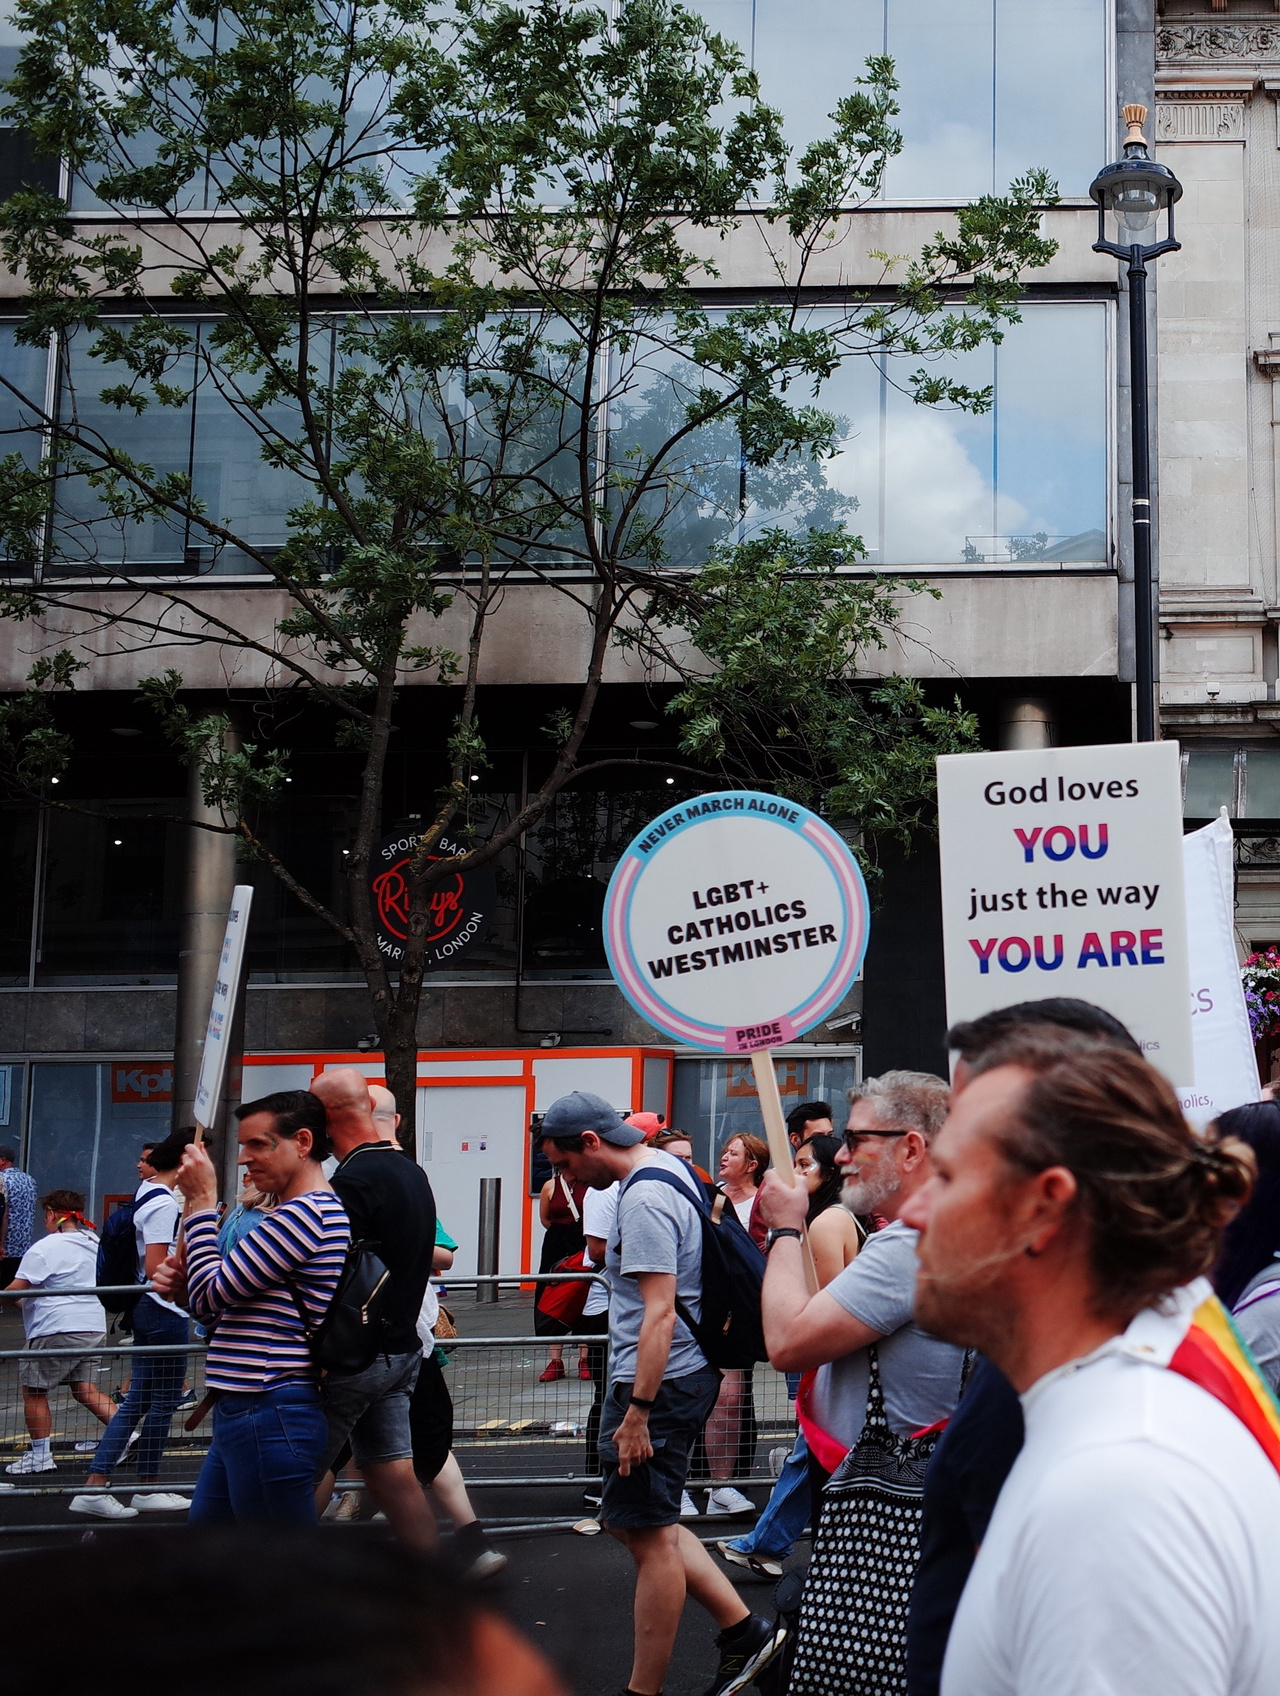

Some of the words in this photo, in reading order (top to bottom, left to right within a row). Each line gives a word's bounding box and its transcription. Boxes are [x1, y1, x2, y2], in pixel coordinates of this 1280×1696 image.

[984, 777, 1048, 806] God
[1058, 776, 1140, 802] loves
[637, 813, 685, 854] NEVER
[686, 798, 745, 820] MARCH
[750, 798, 801, 825] ALONE
[1014, 823, 1110, 864] YOU
[692, 879, 770, 910] LGBT+
[968, 888, 1028, 920] just
[1036, 883, 1088, 909] the
[1097, 884, 1160, 910] way
[435, 911, 484, 960] LONDON
[667, 899, 808, 945] CATHOLICS
[647, 923, 838, 979] WESTMINSTER
[968, 934, 1065, 974] YOU
[1077, 928, 1166, 969] ARE
